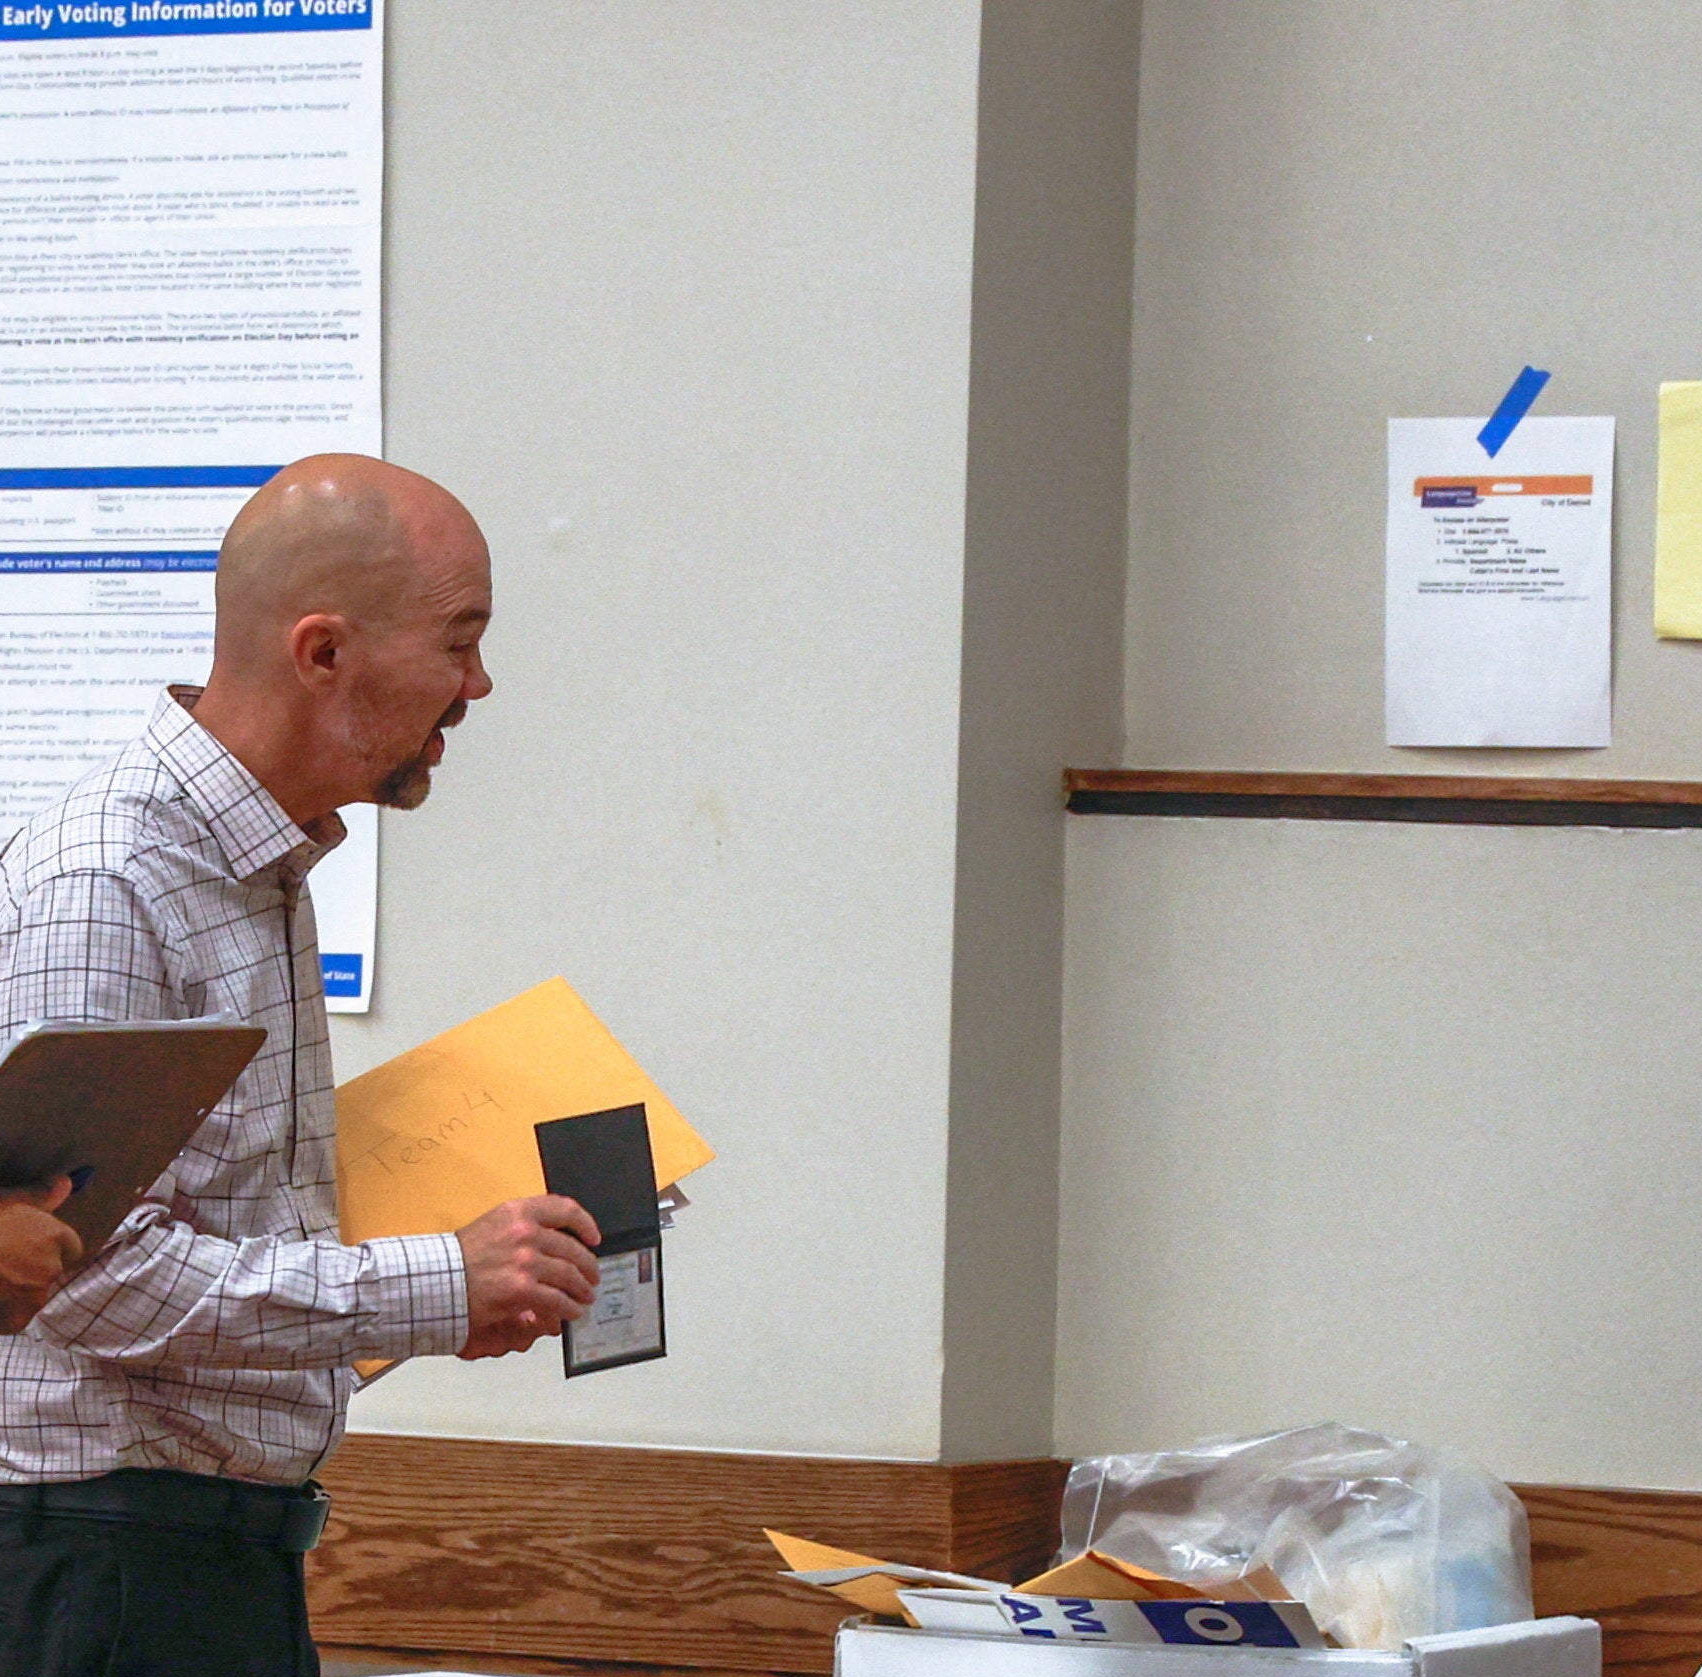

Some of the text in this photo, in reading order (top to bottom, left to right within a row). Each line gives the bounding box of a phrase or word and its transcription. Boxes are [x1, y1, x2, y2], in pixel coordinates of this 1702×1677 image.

[2, 4, 53, 30] Early
[57, 2, 126, 27] Voting
[131, 0, 257, 21] Information
[263, 0, 294, 18] for
[299, 0, 367, 15] Voters
[18, 558, 51, 569] voter's
[55, 559, 81, 569] name
[84, 557, 102, 568] and
[105, 556, 141, 568] address
[339, 1089, 505, 1176] Team 4
